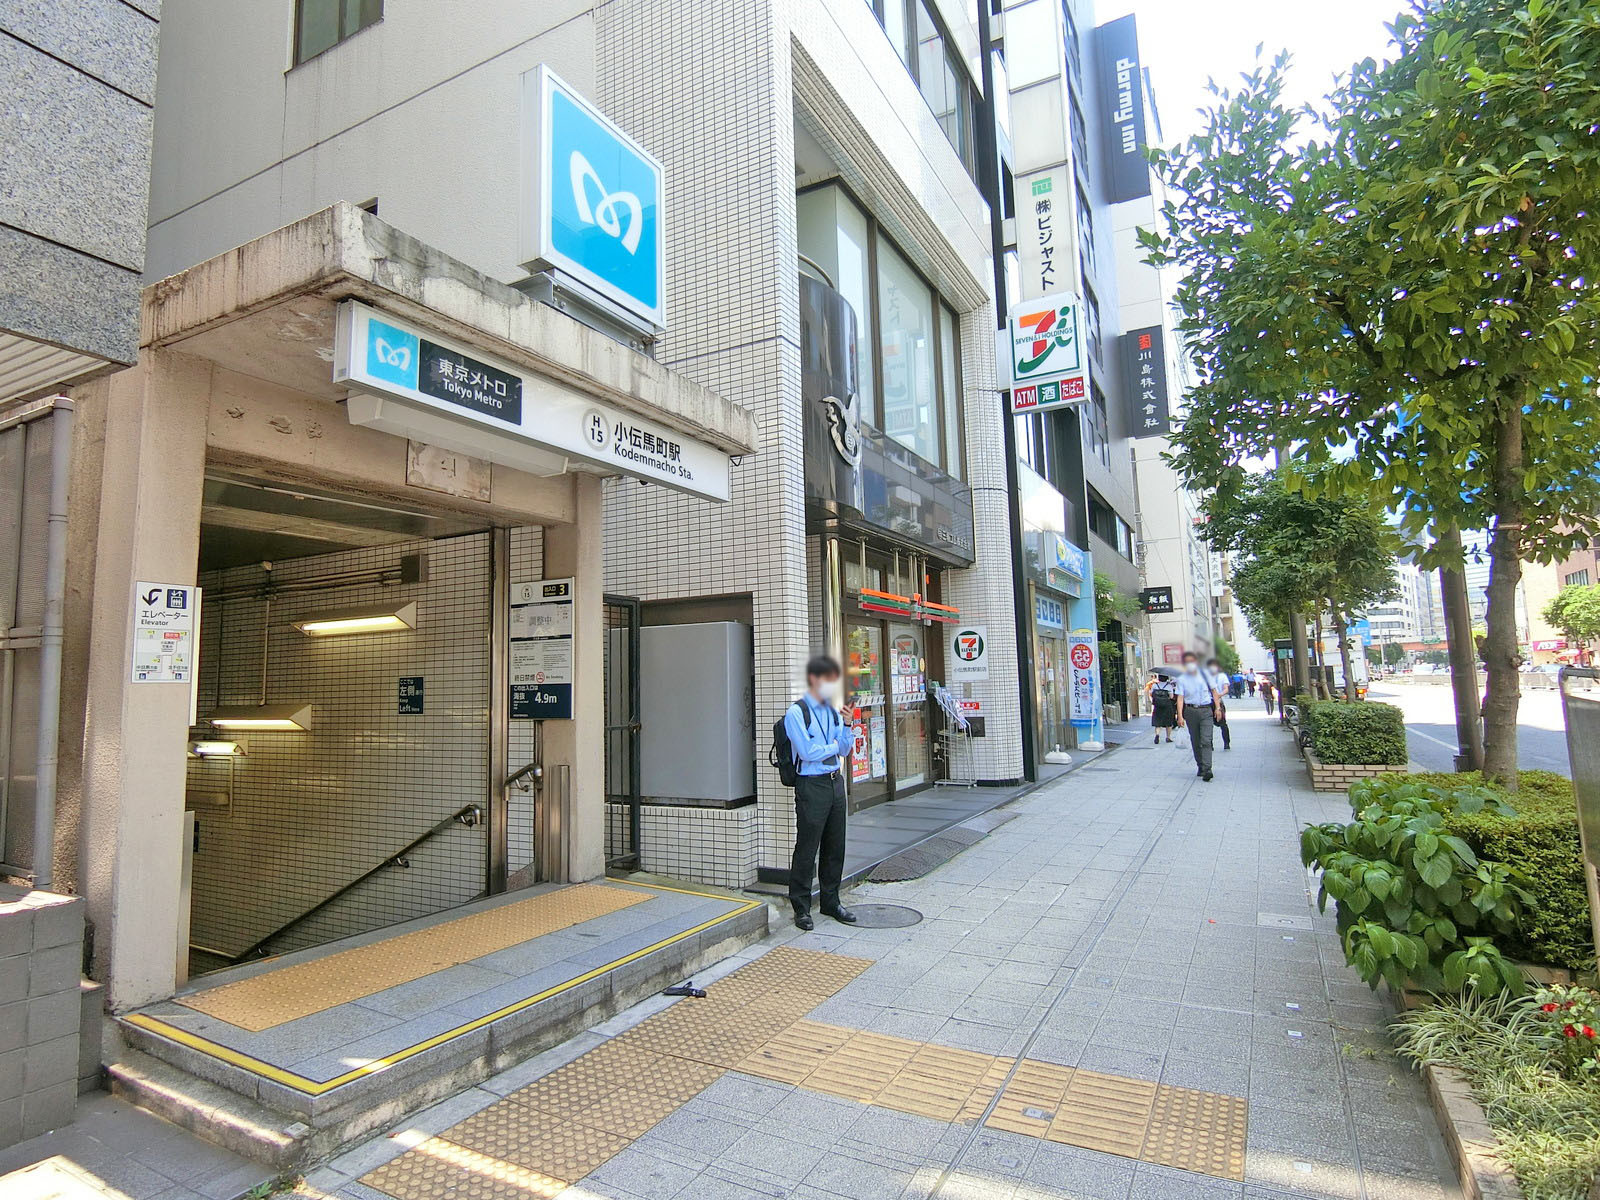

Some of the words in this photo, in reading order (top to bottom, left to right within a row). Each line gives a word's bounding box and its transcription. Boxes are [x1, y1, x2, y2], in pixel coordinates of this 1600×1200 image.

[1114, 58, 1136, 123] dormy
[1121, 124, 1137, 154] inn
[1041, 327, 1073, 339] HOLDINGS
[438, 357, 508, 397] 東京メトロ
[443, 378, 472, 399] Tokyo
[474, 388, 503, 409] Metro
[1041, 385, 1056, 402] 酒
[1061, 380, 1084, 397] たばこ
[1016, 389, 1036, 406] ATM
[592, 414, 601, 428] H
[590, 427, 604, 443] 15
[614, 421, 681, 463] 小伝馬町駅
[614, 442, 677, 475] Kodemmacho
[678, 465, 694, 481] Sta.
[559, 584, 565, 595] 3
[142, 610, 188, 620] エレベーター
[400, 685, 415, 696] 左側
[534, 692, 557, 704] 4.9m
[400, 704, 411, 712] Left
